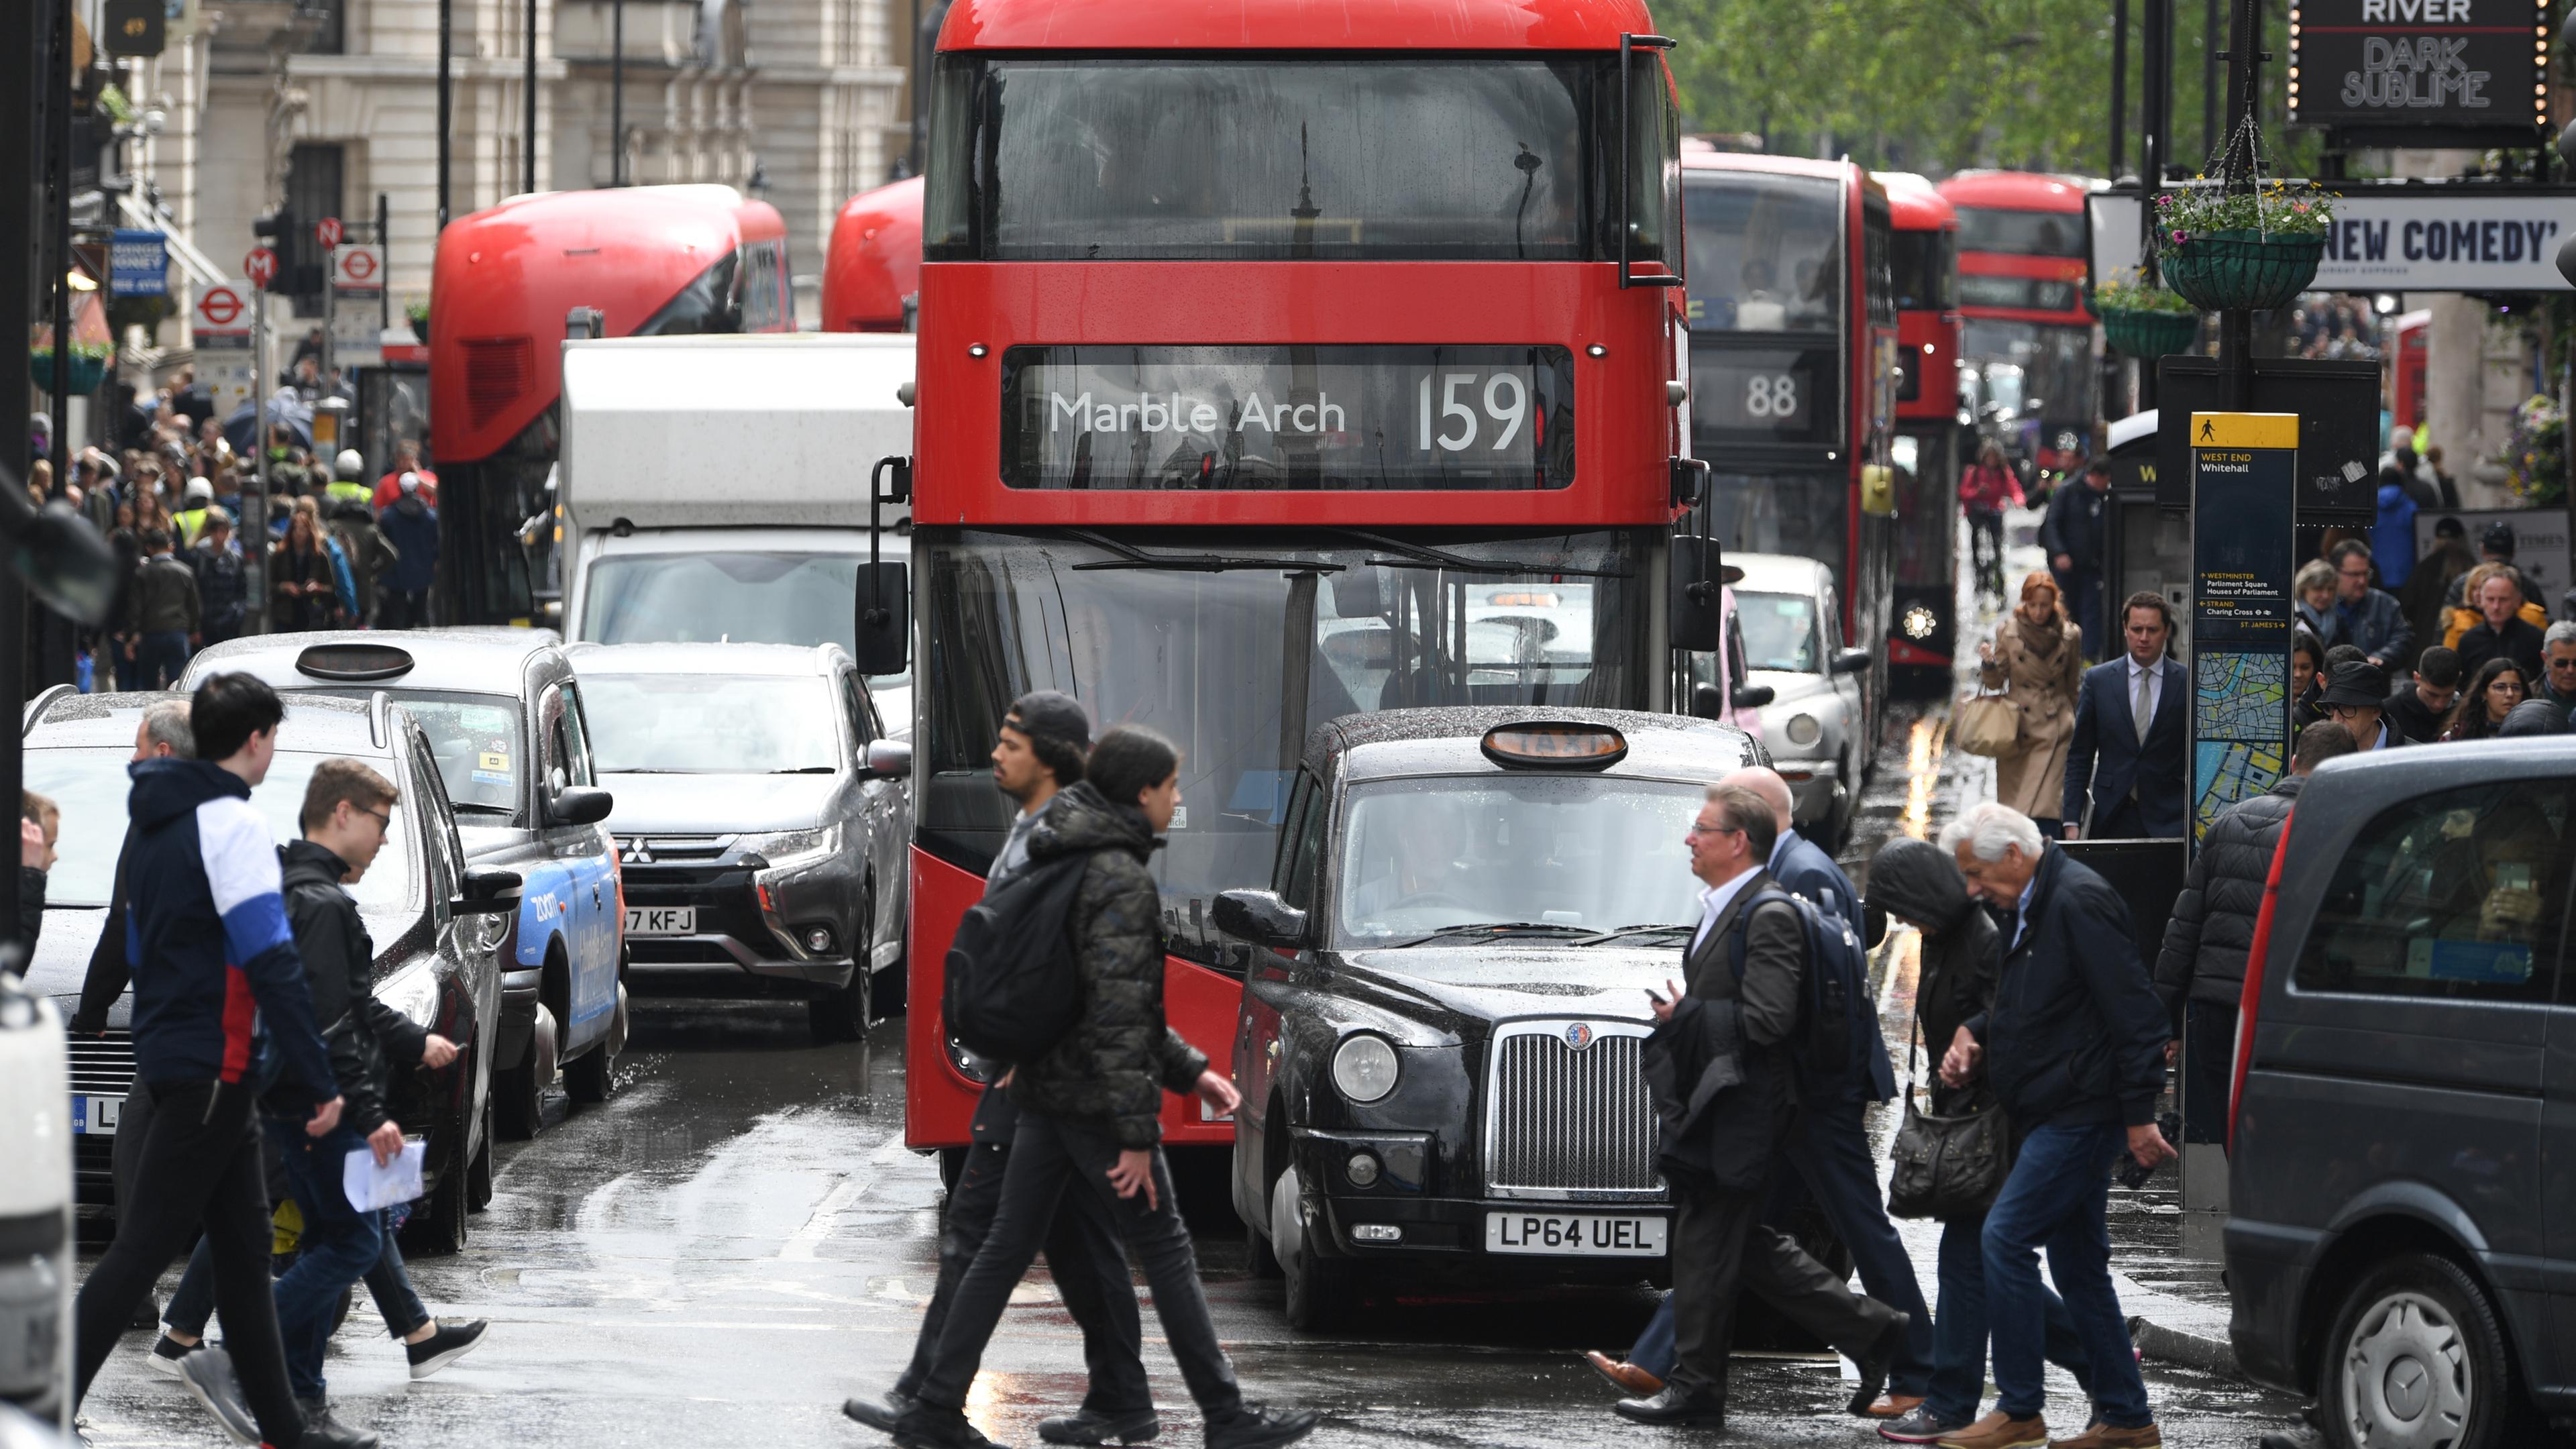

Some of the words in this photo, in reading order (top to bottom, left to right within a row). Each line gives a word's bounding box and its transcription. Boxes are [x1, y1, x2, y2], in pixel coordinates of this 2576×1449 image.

[2361, 0, 2472, 23] RIVER
[2363, 36, 2468, 73] DARK
[2341, 70, 2491, 107] SUBLIME
[320, 225, 339, 241] N
[2322, 219, 2390, 262] NEW
[248, 257, 270, 276] M
[1747, 374, 1797, 417] 88
[1051, 392, 1218, 433] Marble
[1236, 391, 1344, 433] Arch
[1419, 372, 1526, 451] 159
[2201, 453, 2227, 462] WEST
[2231, 453, 2251, 462] END
[2201, 464, 2249, 472] Whitehall
[2206, 608, 2233, 616] Charing
[1519, 730, 1597, 753] TAXI
[530, 892, 559, 922] zoom
[625, 910, 642, 930] 7
[649, 910, 692, 930] KFJ
[74, 1119, 84, 1127] GB
[1501, 1217, 1582, 1248] LP64
[1593, 1220, 1652, 1249] UEL
